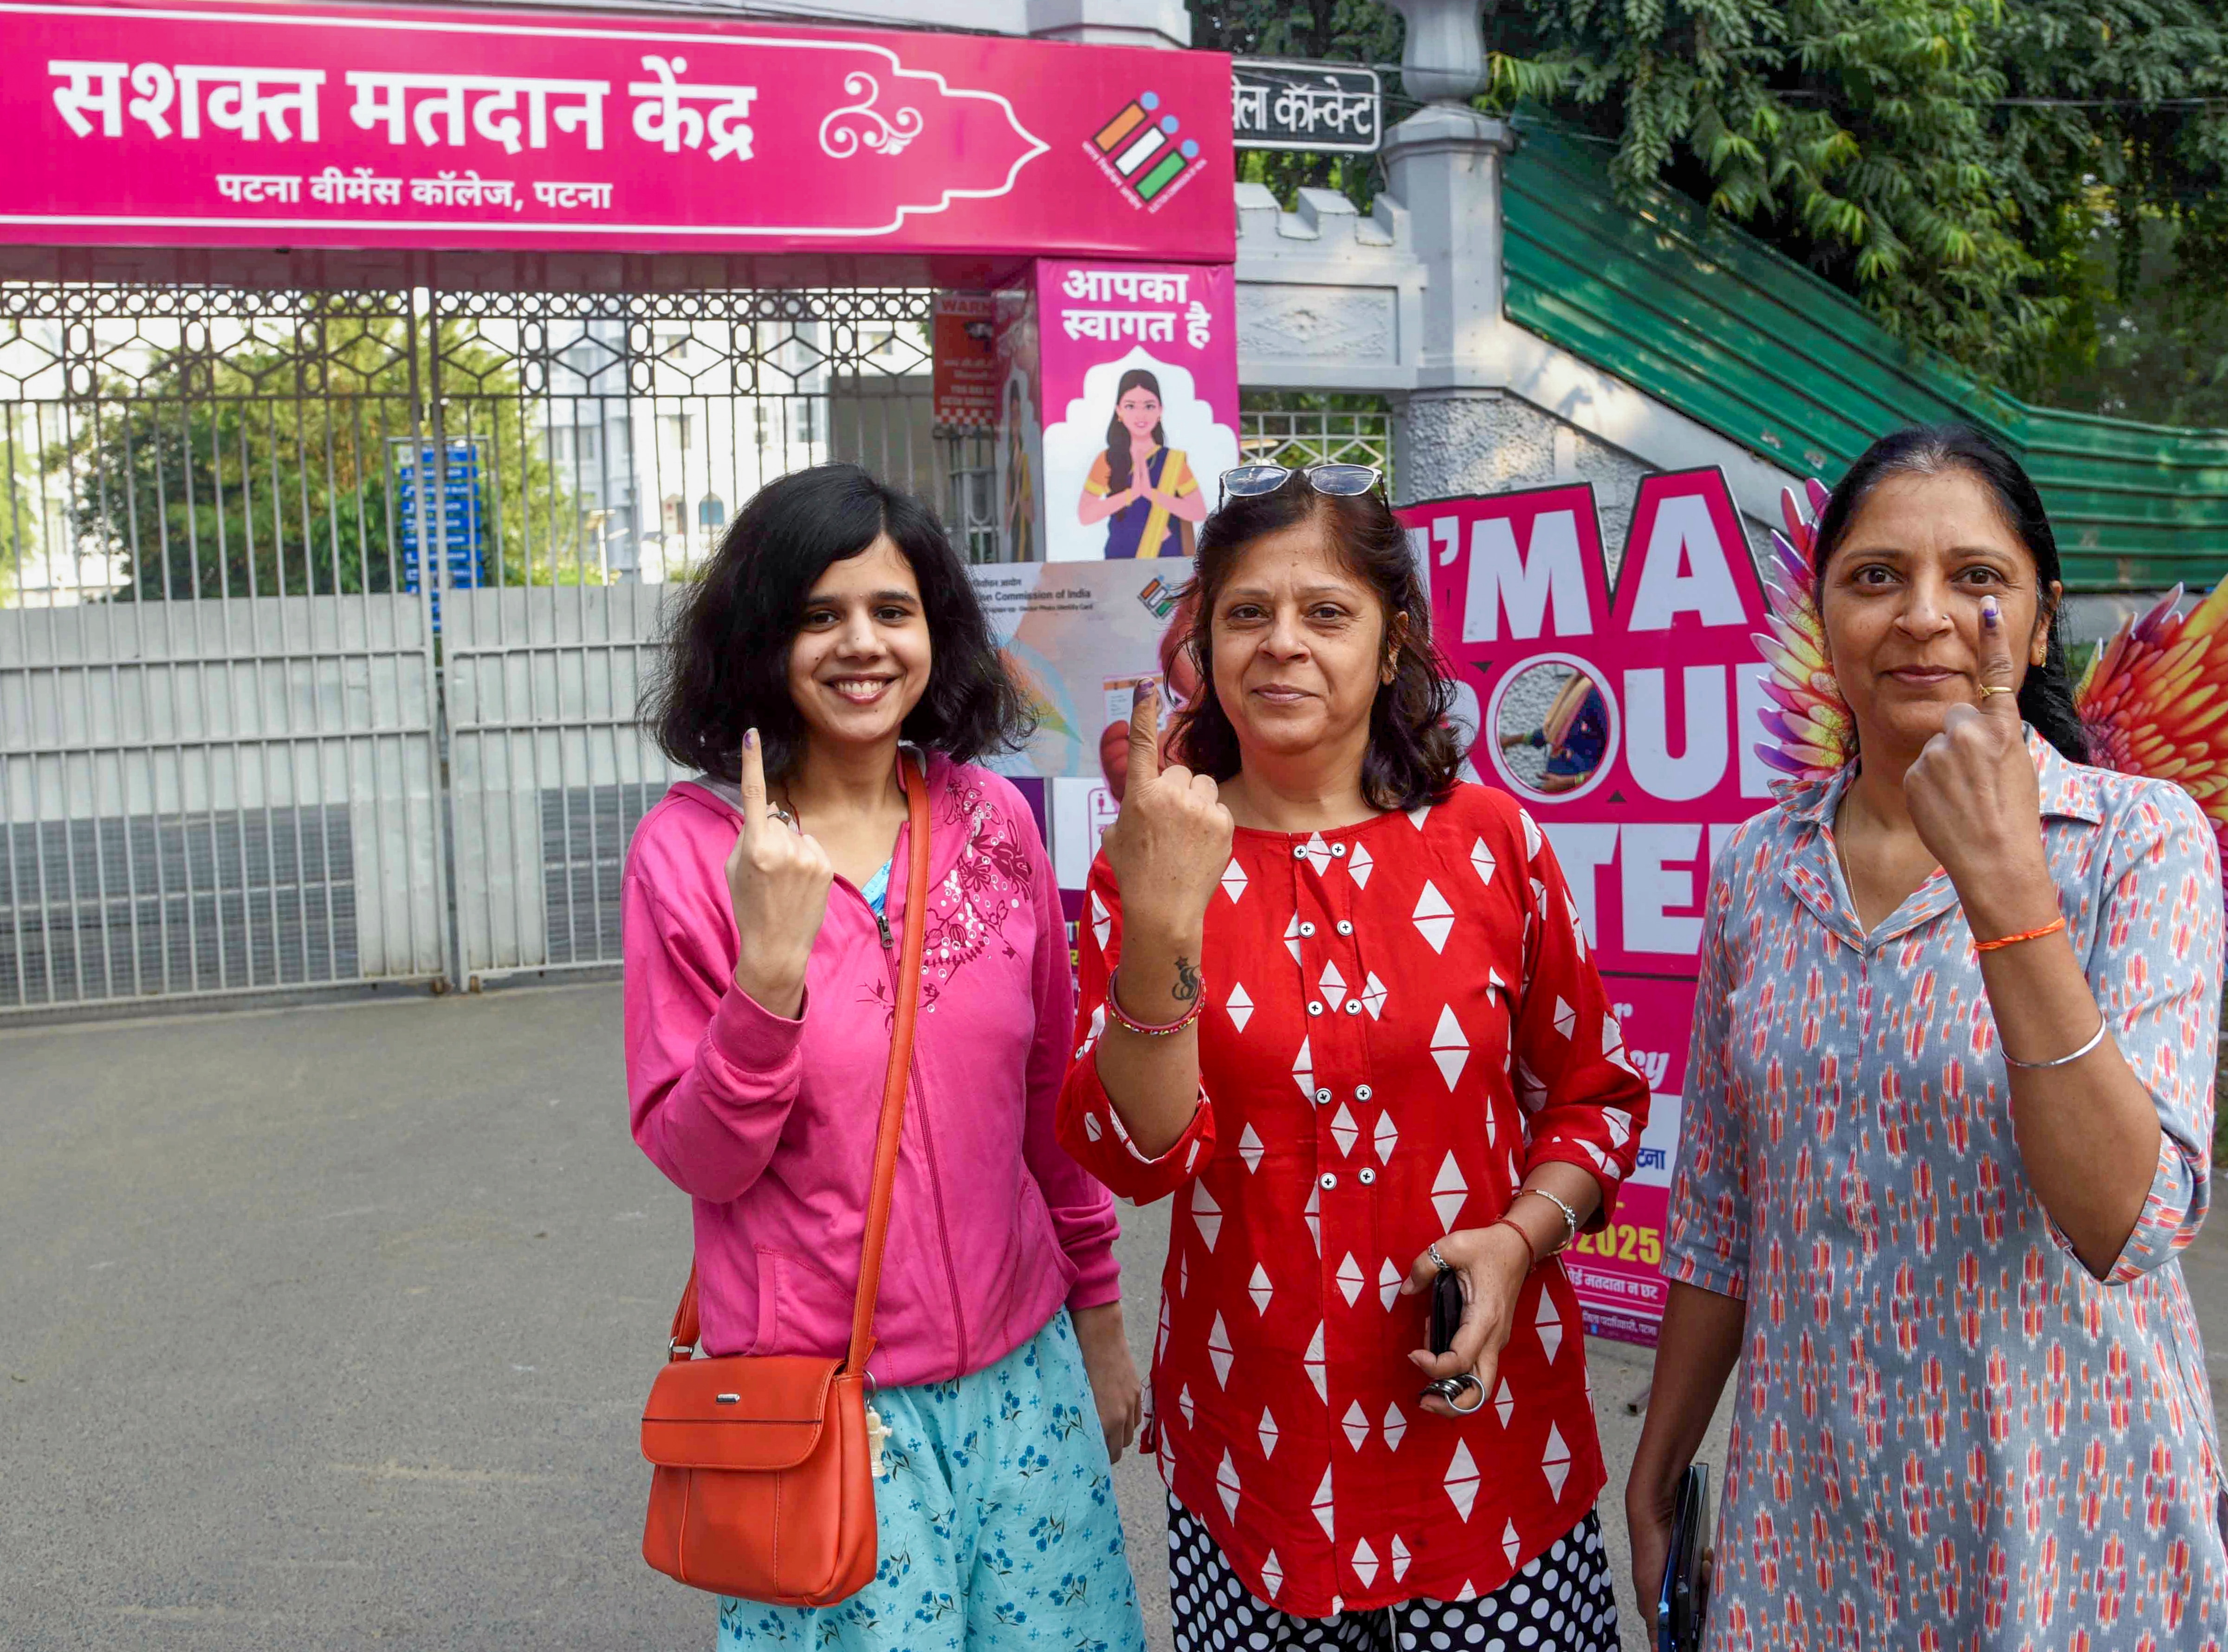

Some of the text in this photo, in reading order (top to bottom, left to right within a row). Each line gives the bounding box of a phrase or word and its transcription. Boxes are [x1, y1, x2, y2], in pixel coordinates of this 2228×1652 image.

[49, 56, 757, 161] सशक्त मतदान केंद्र
[216, 167, 612, 211] पटना वीमेंस कॉलेज, पटना
[1062, 270, 1188, 304] आपका
[1062, 301, 1211, 349] स्वागत है
[1627, 494, 1748, 632] A
[995, 590, 1054, 601] Commission
[1055, 589, 1066, 599] of
[1068, 588, 1091, 599] India
[1583, 1273, 1625, 1294] मतदाता
[1626, 1281, 1639, 1296] न
